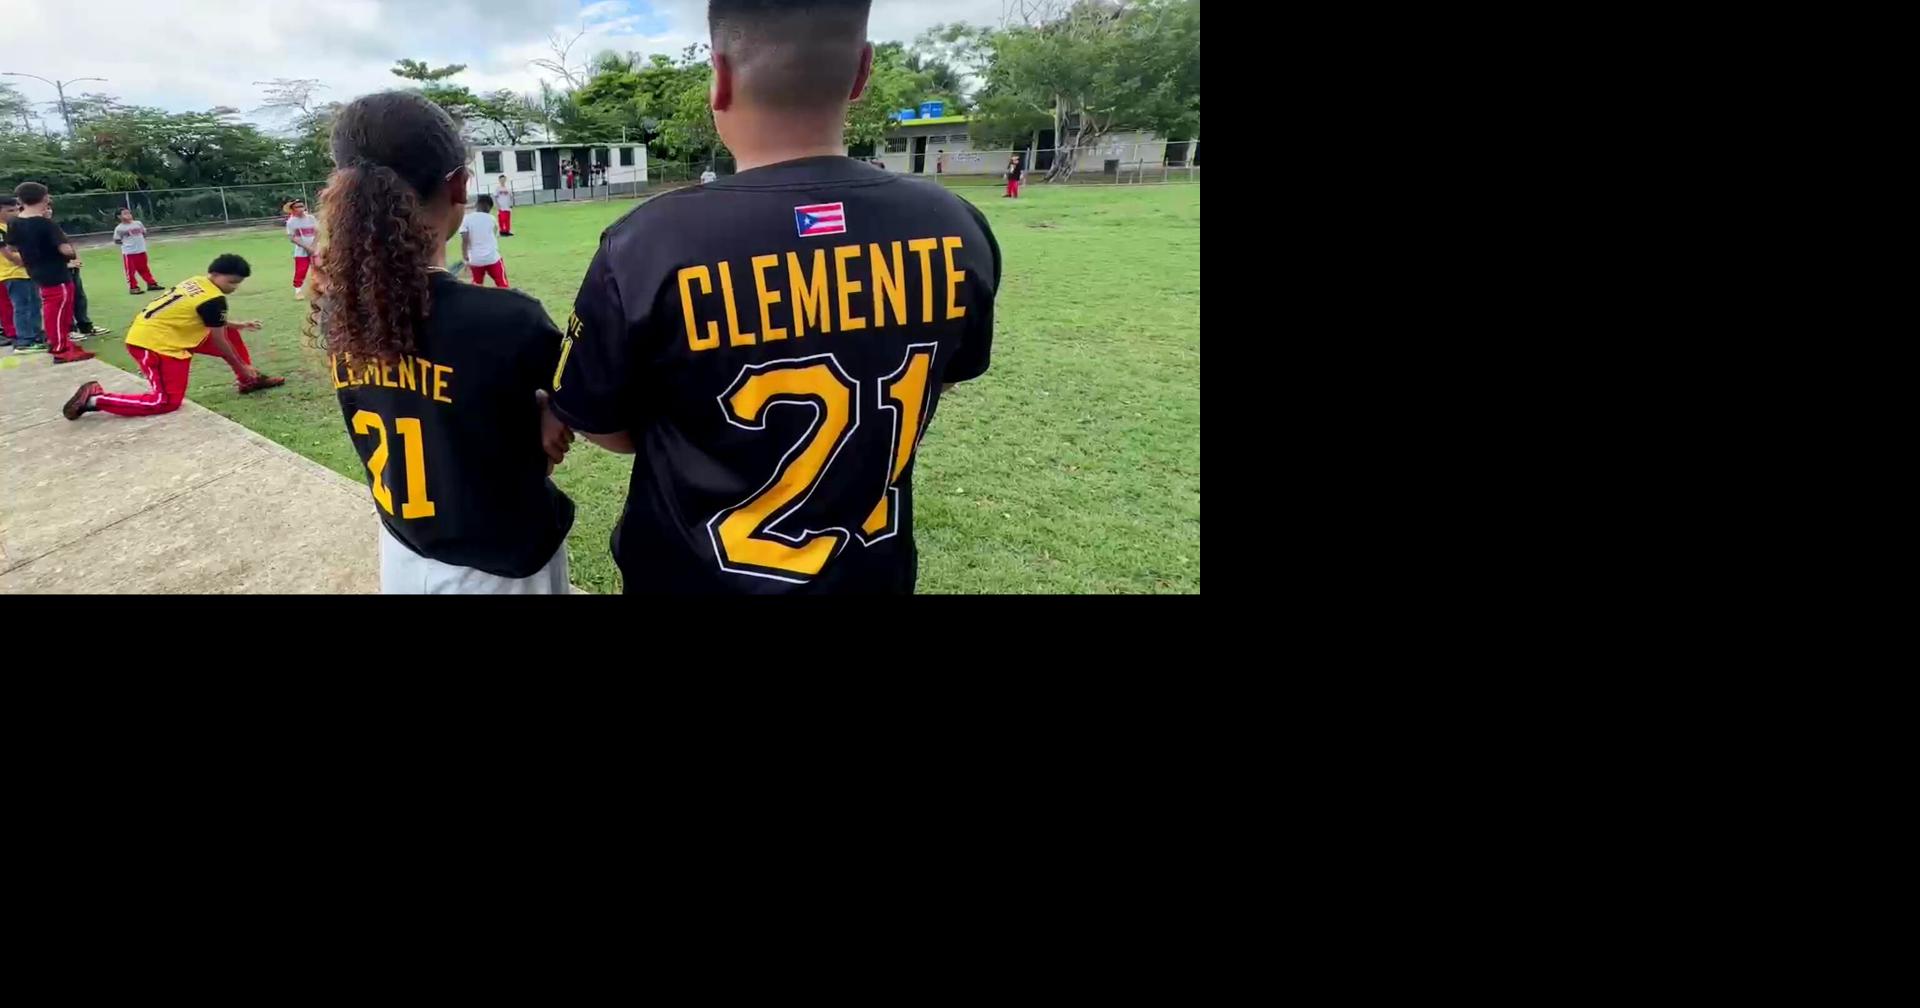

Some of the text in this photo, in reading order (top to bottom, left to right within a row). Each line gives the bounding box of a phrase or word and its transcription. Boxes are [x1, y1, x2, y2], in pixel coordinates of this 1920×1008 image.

[678, 236, 966, 352] CLEMENTE
[351, 408, 436, 519] 21
[706, 341, 938, 584] 21
